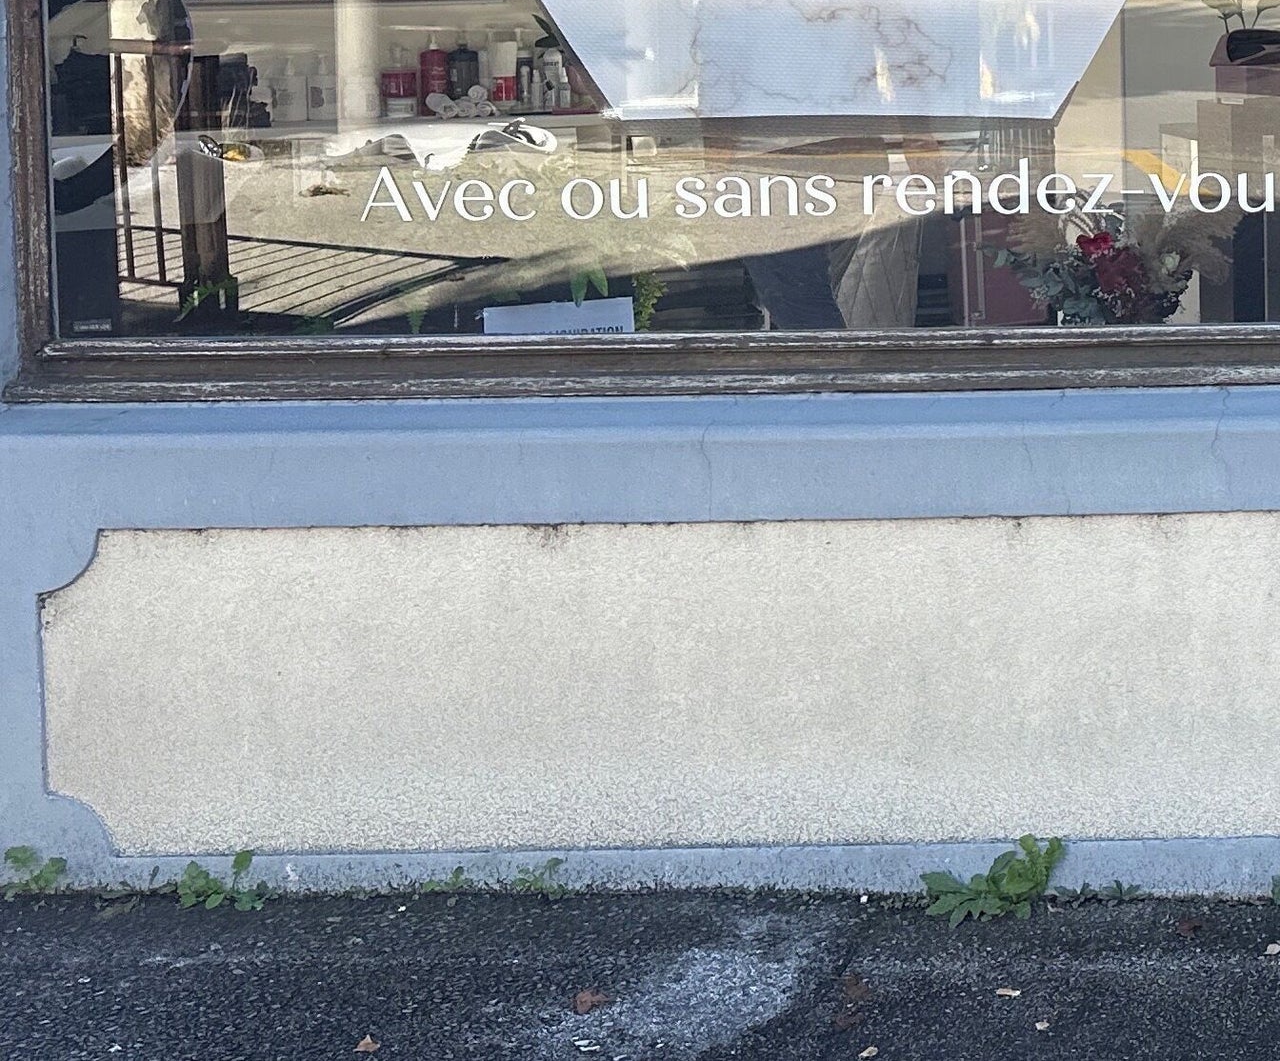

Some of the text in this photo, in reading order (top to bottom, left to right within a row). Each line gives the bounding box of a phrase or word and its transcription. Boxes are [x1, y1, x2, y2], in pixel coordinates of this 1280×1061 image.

[359, 165, 538, 223] Avec
[560, 177, 650, 220] ou
[675, 173, 838, 219] sans
